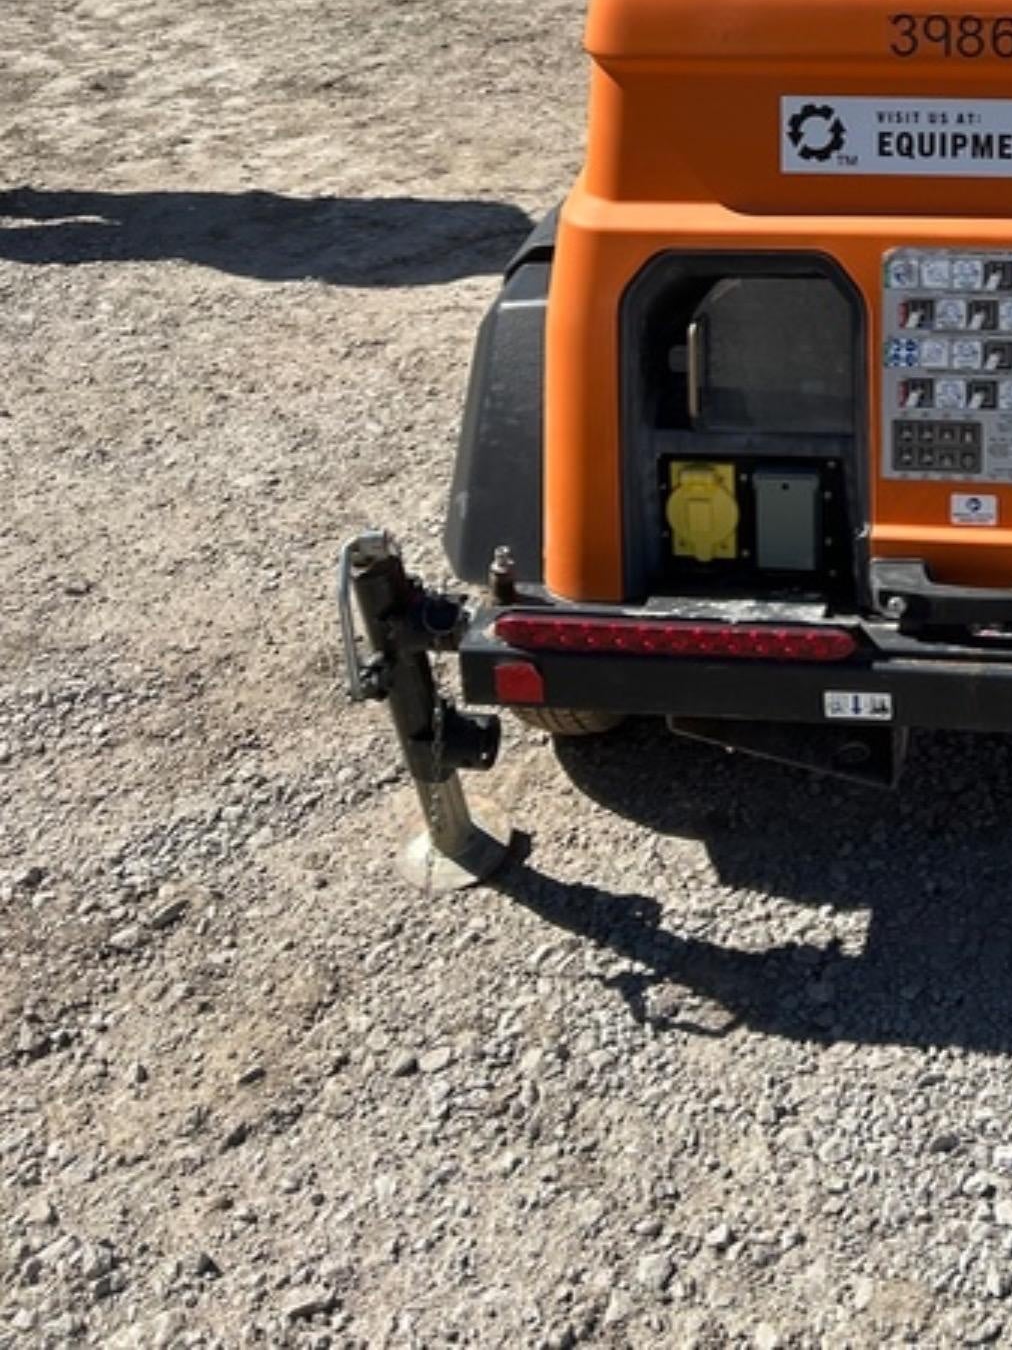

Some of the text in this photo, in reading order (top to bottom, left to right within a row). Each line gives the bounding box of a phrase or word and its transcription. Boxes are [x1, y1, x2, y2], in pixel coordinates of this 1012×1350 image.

[876, 111, 982, 125] VISIT US AT:
[836, 155, 859, 167] TM
